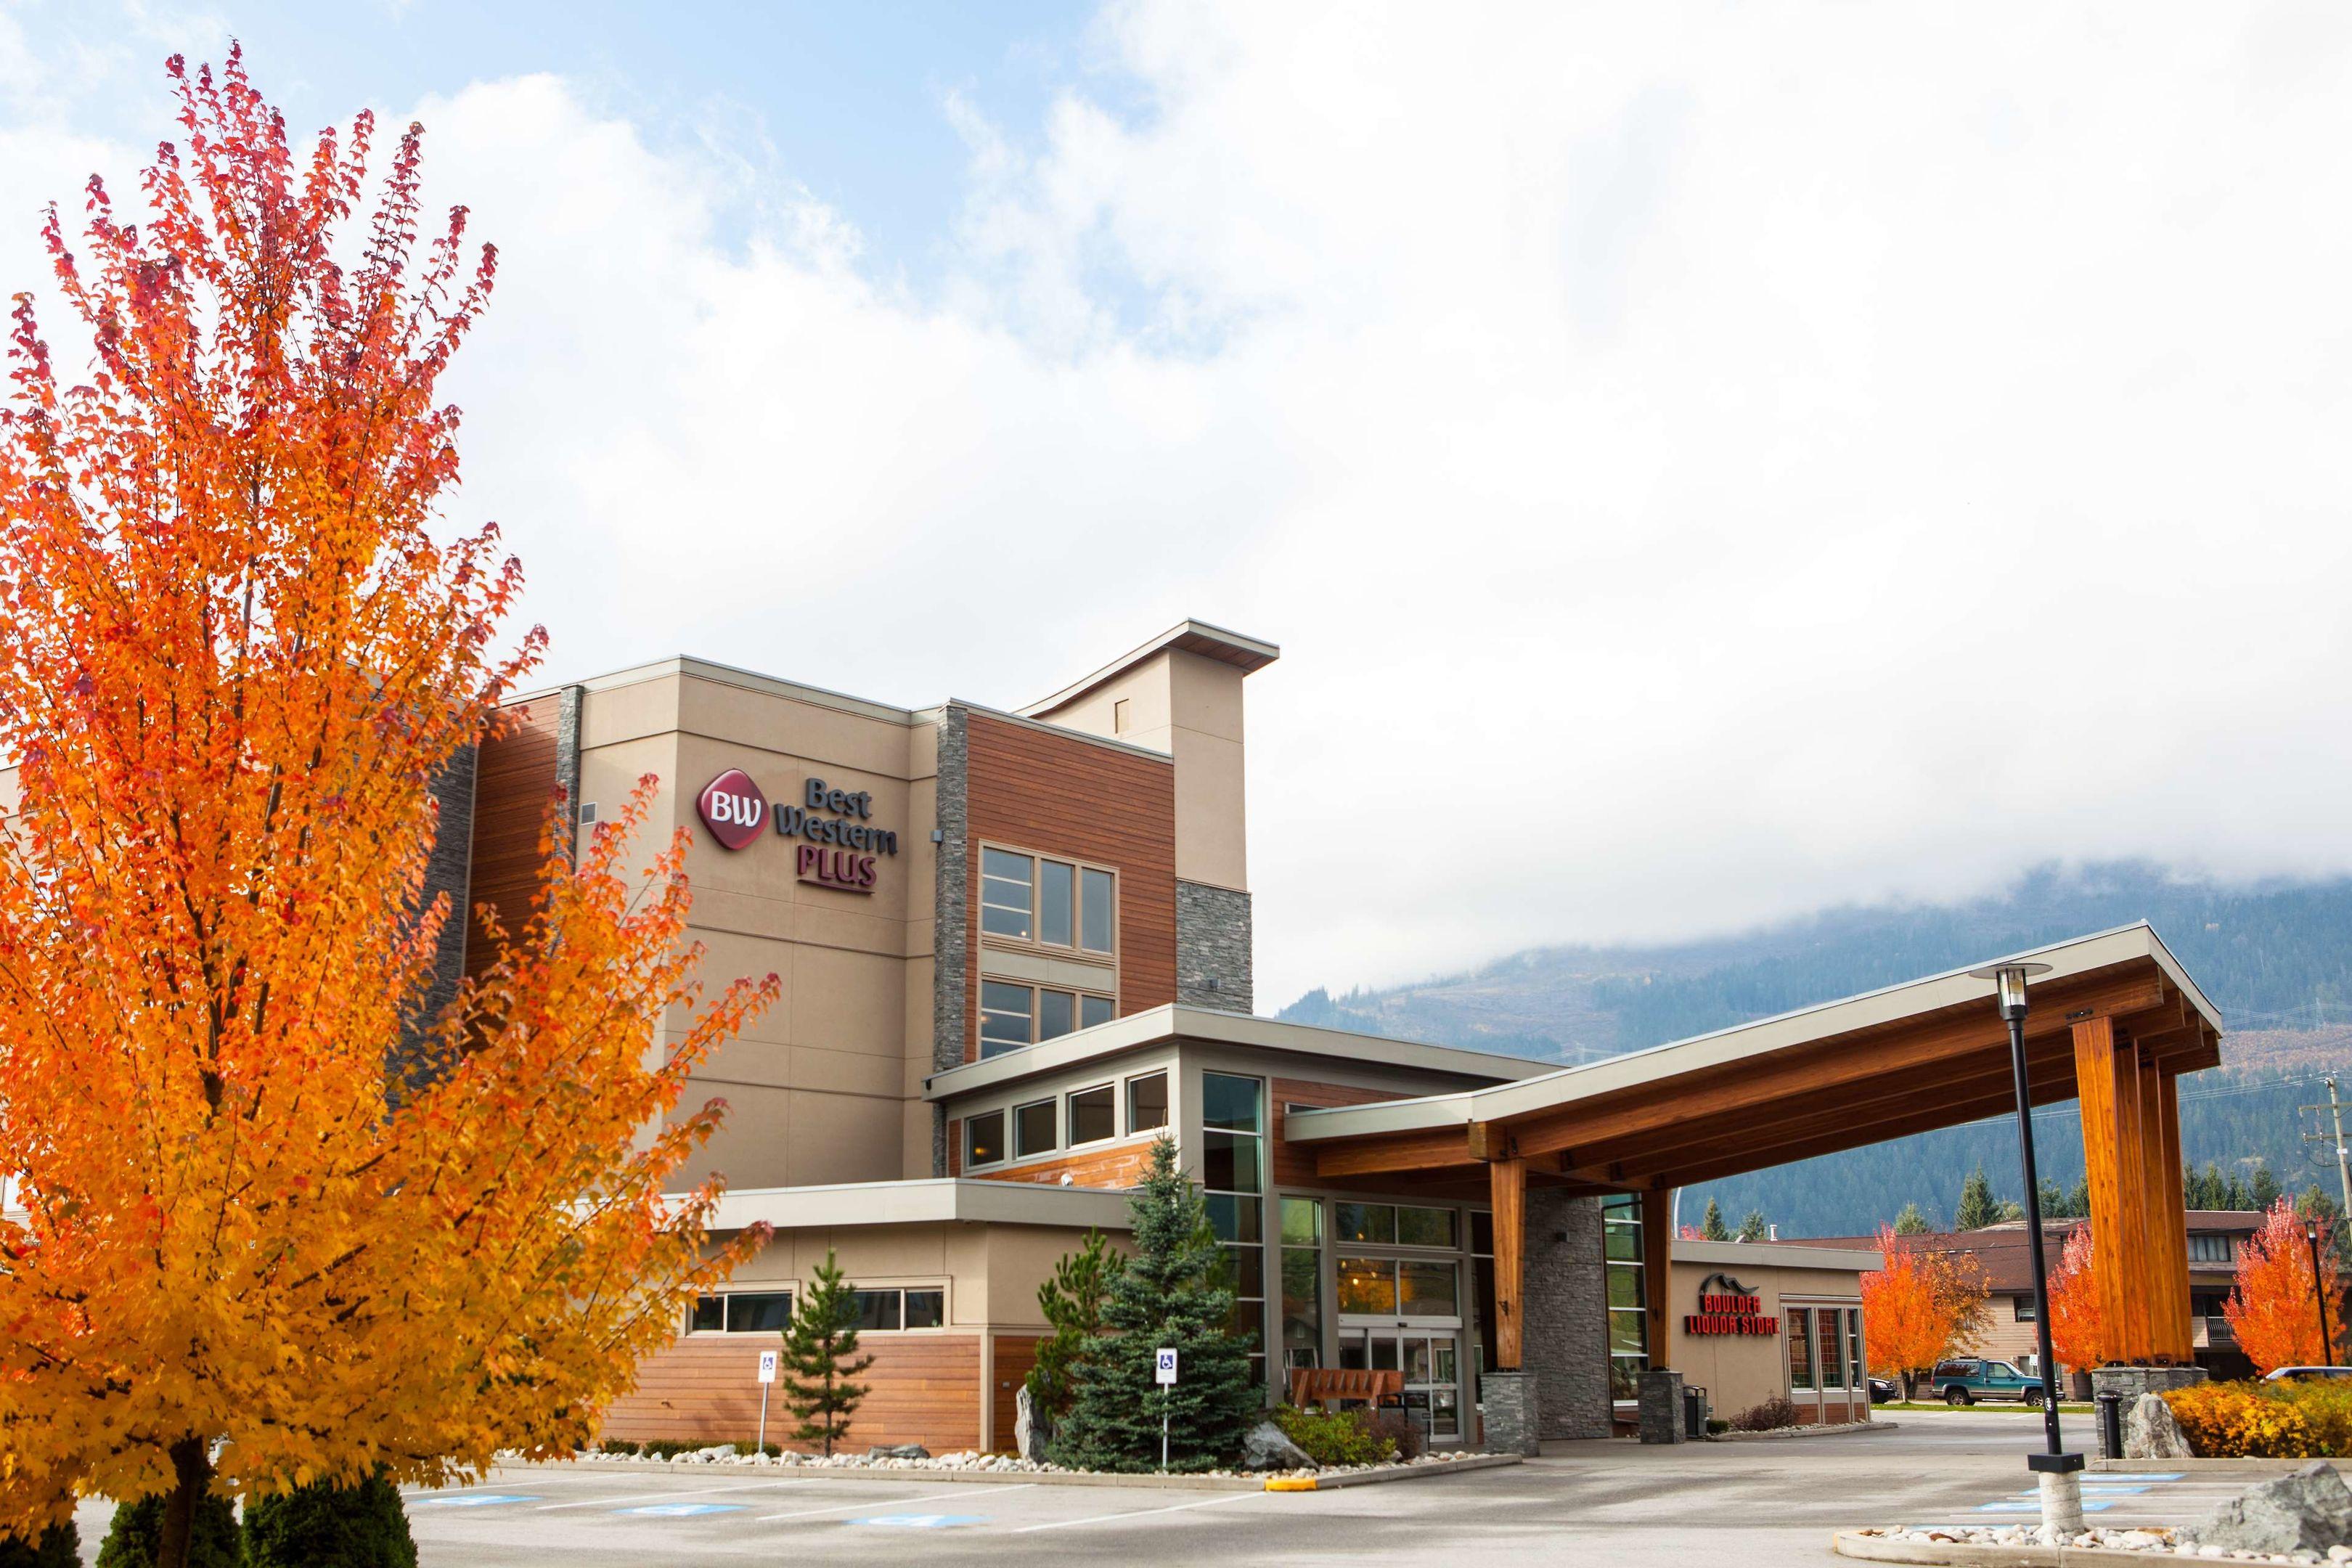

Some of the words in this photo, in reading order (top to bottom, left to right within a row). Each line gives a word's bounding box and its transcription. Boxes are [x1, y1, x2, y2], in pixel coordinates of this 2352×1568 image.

[711, 791, 761, 828] BW
[805, 777, 873, 820] Best
[774, 803, 898, 855] Western
[798, 844, 877, 886] PLUS
[1702, 1294, 1761, 1314] BOULDER
[1686, 1315, 1738, 1336] LIQUOR
[1742, 1317, 1779, 1336] STORE
